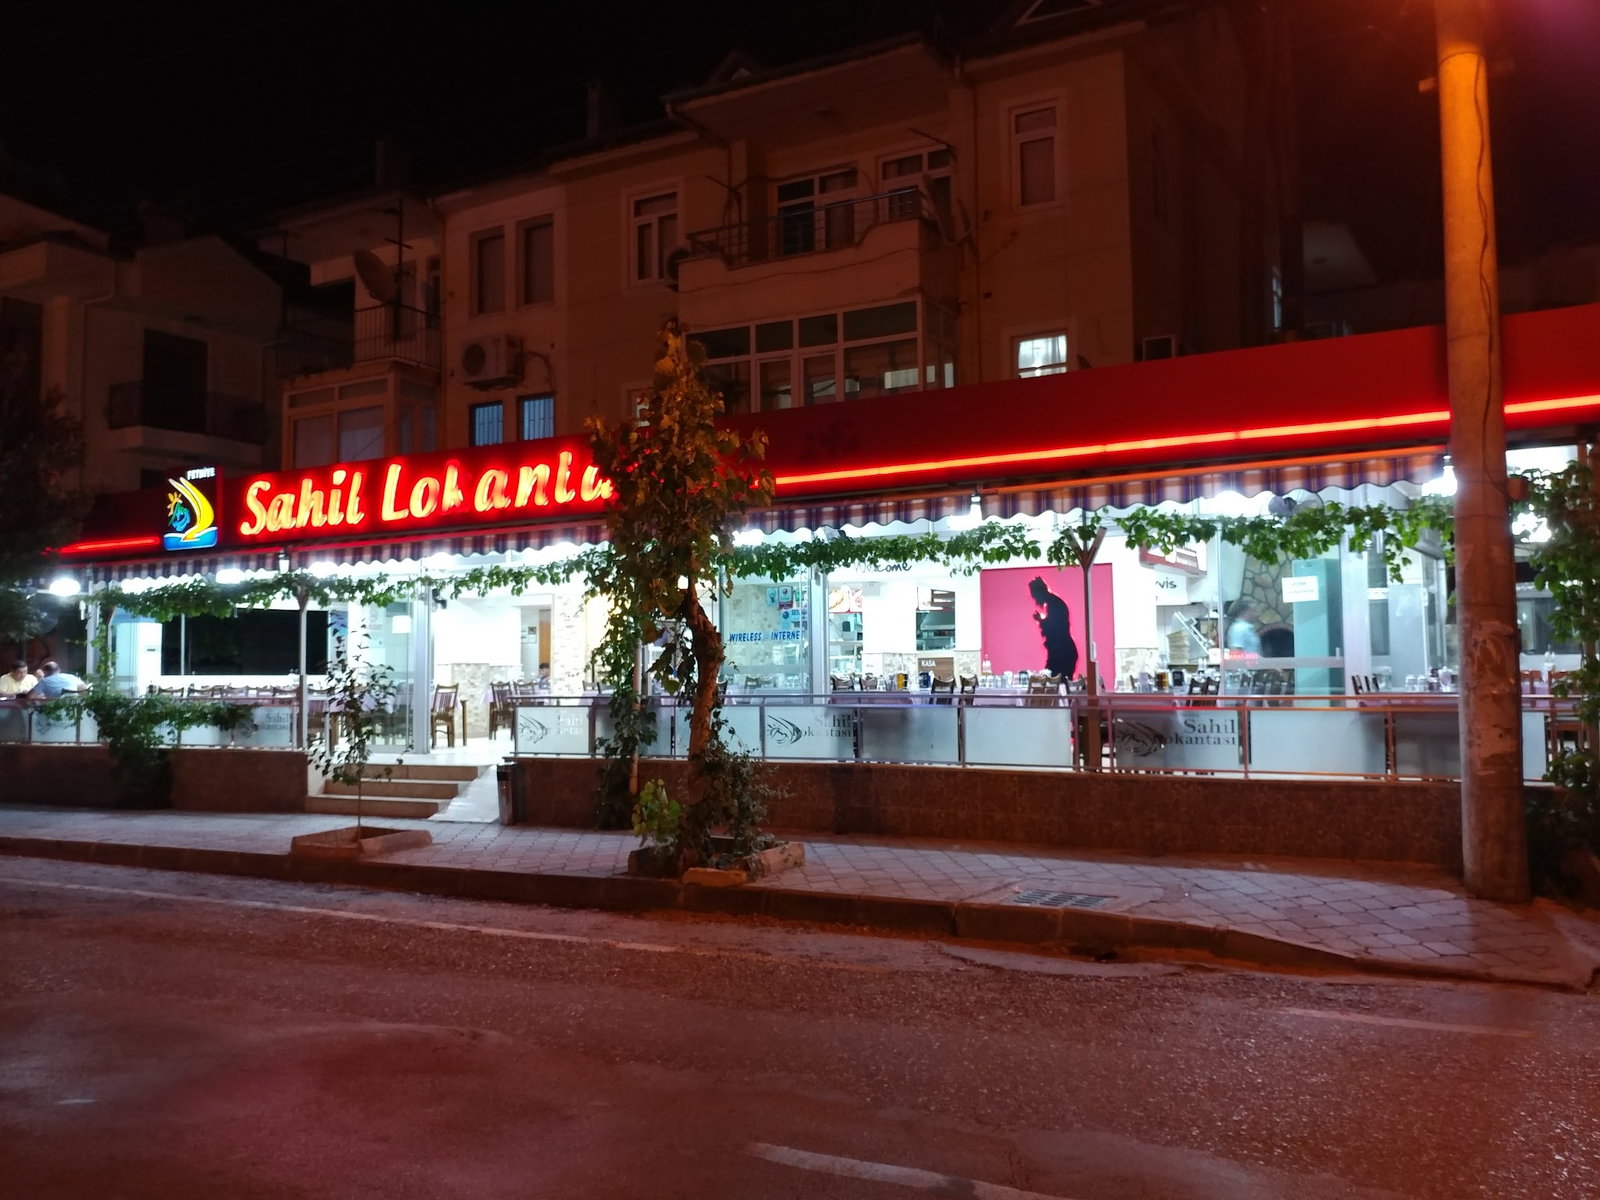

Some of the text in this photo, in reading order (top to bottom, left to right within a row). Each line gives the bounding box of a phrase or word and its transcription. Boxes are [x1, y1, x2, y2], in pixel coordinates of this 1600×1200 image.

[240, 470, 365, 535] Sahil
[730, 632, 761, 641] WIRELESS
[1184, 719, 1235, 733] Sahil
